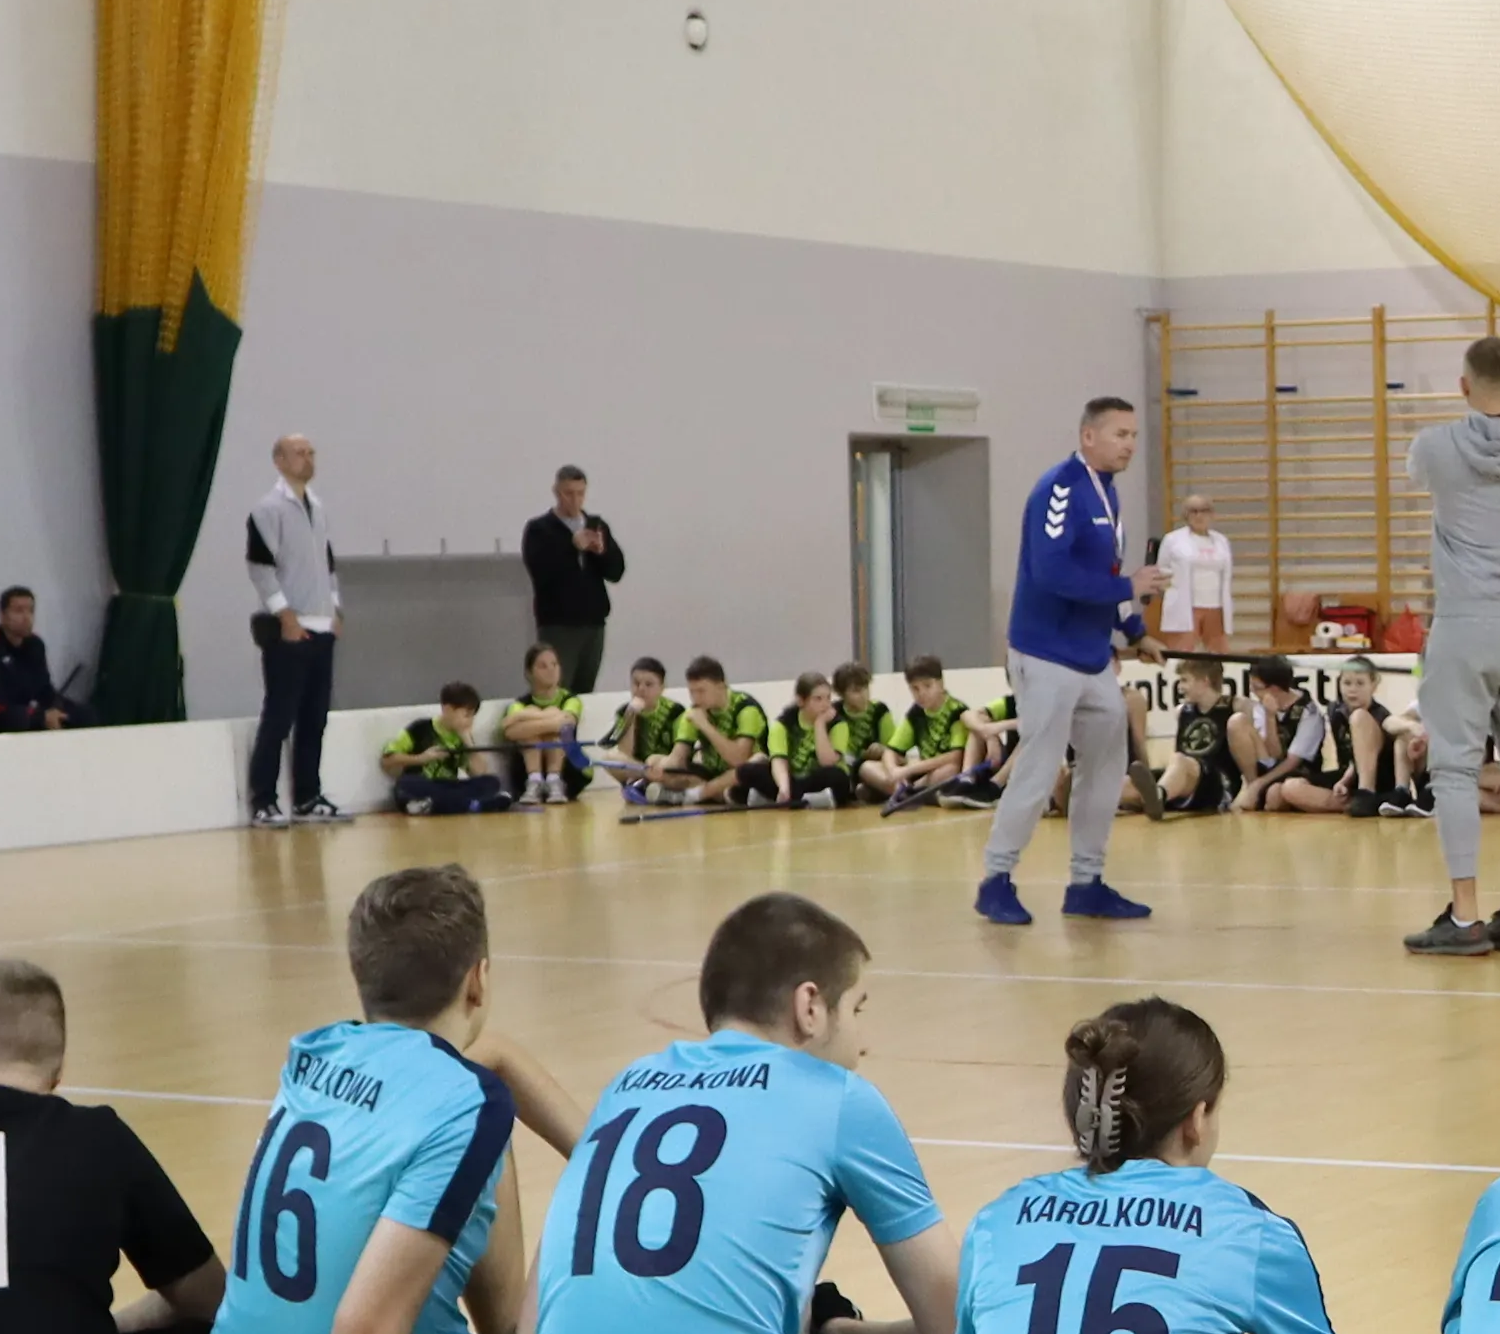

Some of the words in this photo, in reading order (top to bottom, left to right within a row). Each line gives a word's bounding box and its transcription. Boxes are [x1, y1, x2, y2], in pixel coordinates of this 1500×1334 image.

[235, 1107, 330, 1303] 16
[572, 1105, 728, 1278] 18
[1017, 1196, 1201, 1237] KAROLKOWA
